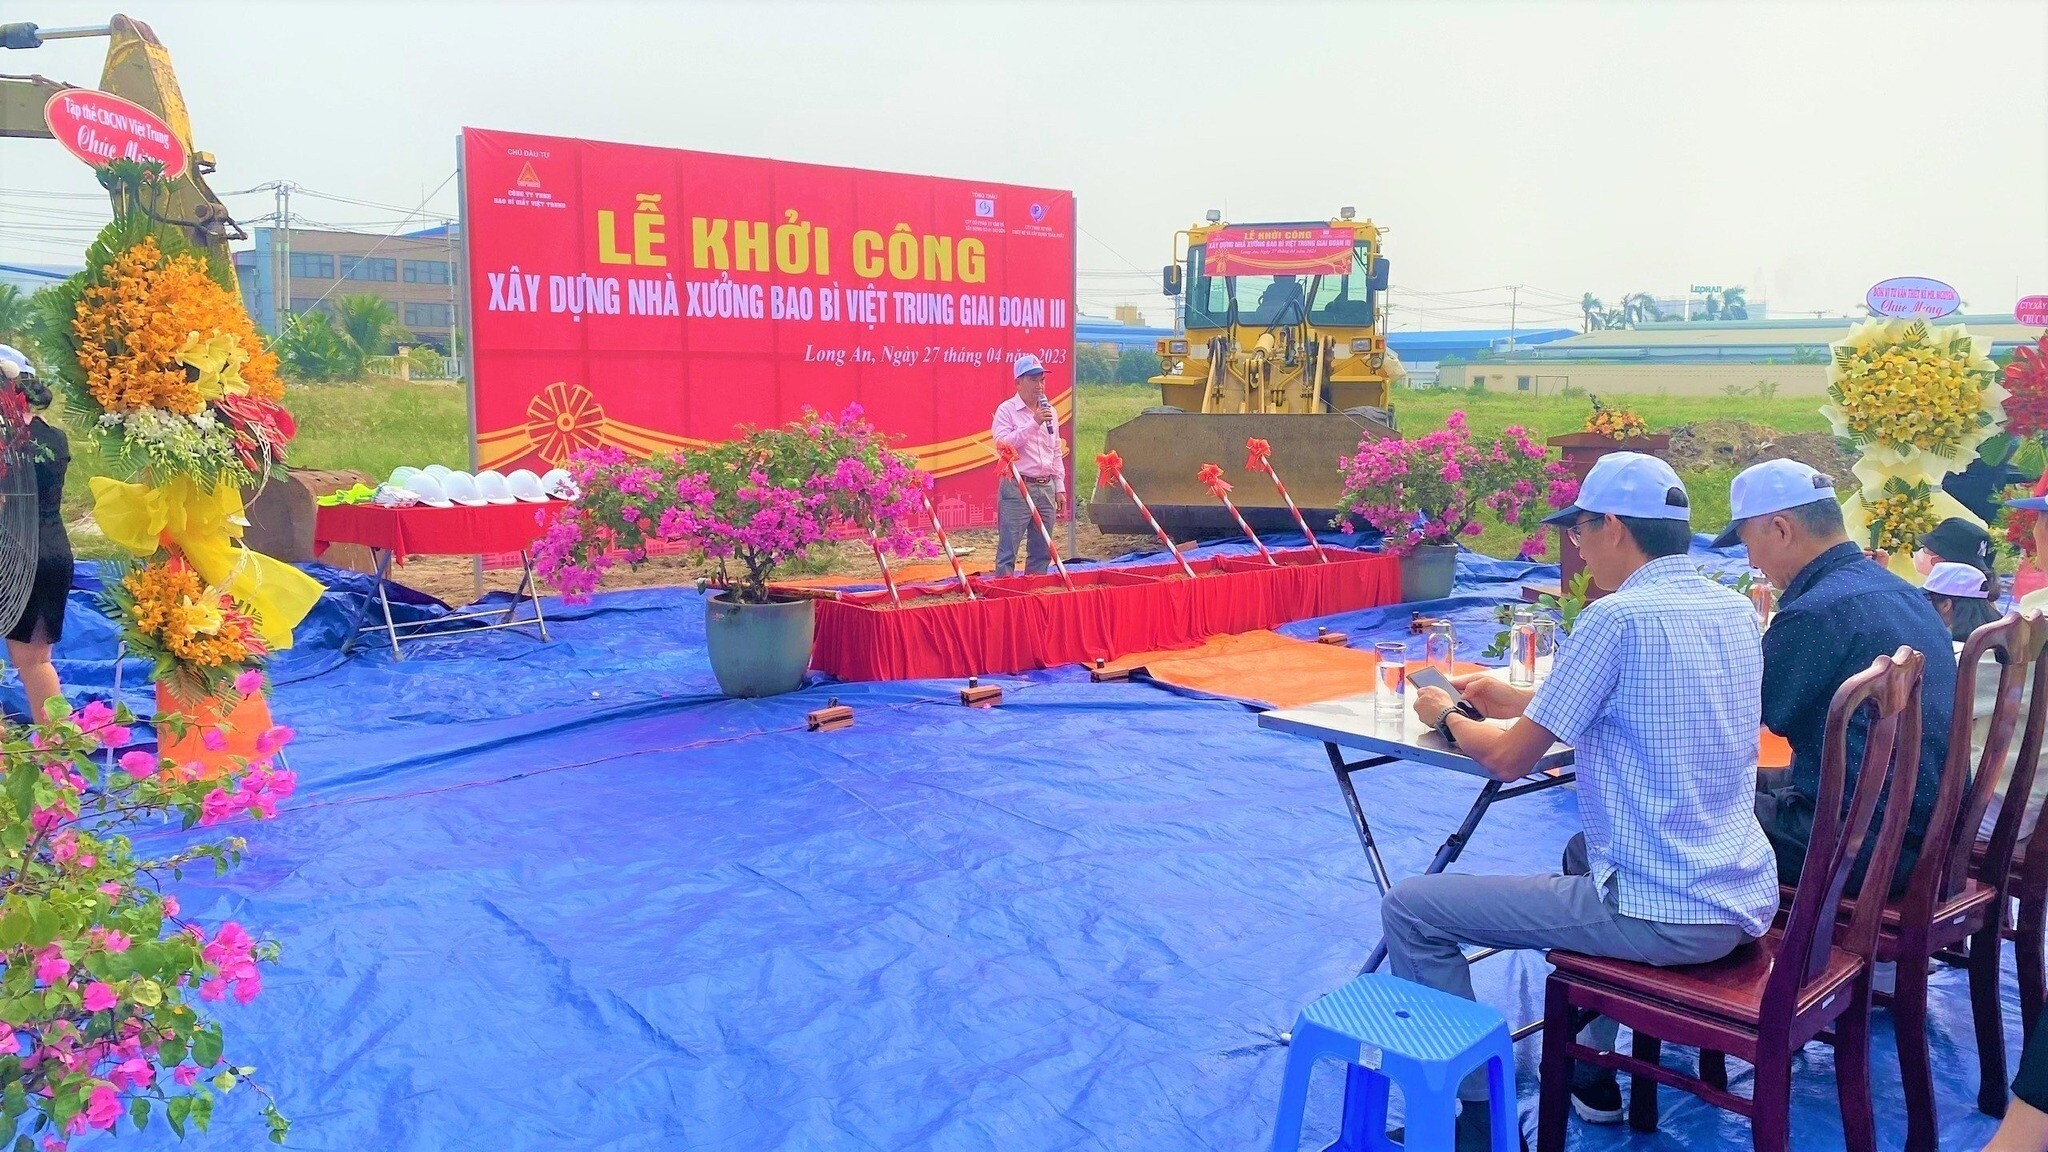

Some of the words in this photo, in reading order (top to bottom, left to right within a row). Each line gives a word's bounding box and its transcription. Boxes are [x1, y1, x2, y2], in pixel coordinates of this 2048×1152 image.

[64, 97, 81, 120] Tập
[97, 108, 128, 132] CBCNV
[128, 118, 147, 141] Việt
[146, 122, 170, 150] Trung
[77, 125, 117, 160] Chúc
[597, 193, 667, 267] LỄ
[691, 208, 830, 276] KHỞI
[852, 222, 986, 284] CÔNG
[1285, 229, 1312, 240] CÔNG
[487, 265, 541, 313] XÂY
[549, 272, 621, 322] DỰNG
[627, 271, 680, 317] NHÀ
[685, 270, 764, 319] XƯỞNG
[770, 285, 813, 322] BAO
[820, 280, 841, 322] BÌ
[845, 283, 888, 330] VIỆT
[893, 291, 954, 325] TRUNG
[959, 294, 995, 327] GIAI
[999, 295, 1045, 333] ĐOẠN
[1049, 298, 1066, 329] III
[804, 344, 847, 367] Long
[849, 344, 877, 365] An,
[880, 345, 919, 367] Ngày
[922, 346, 940, 363] 27
[943, 345, 982, 368] tháng
[986, 347, 1002, 363] 04
[1038, 348, 1067, 364] 2023
